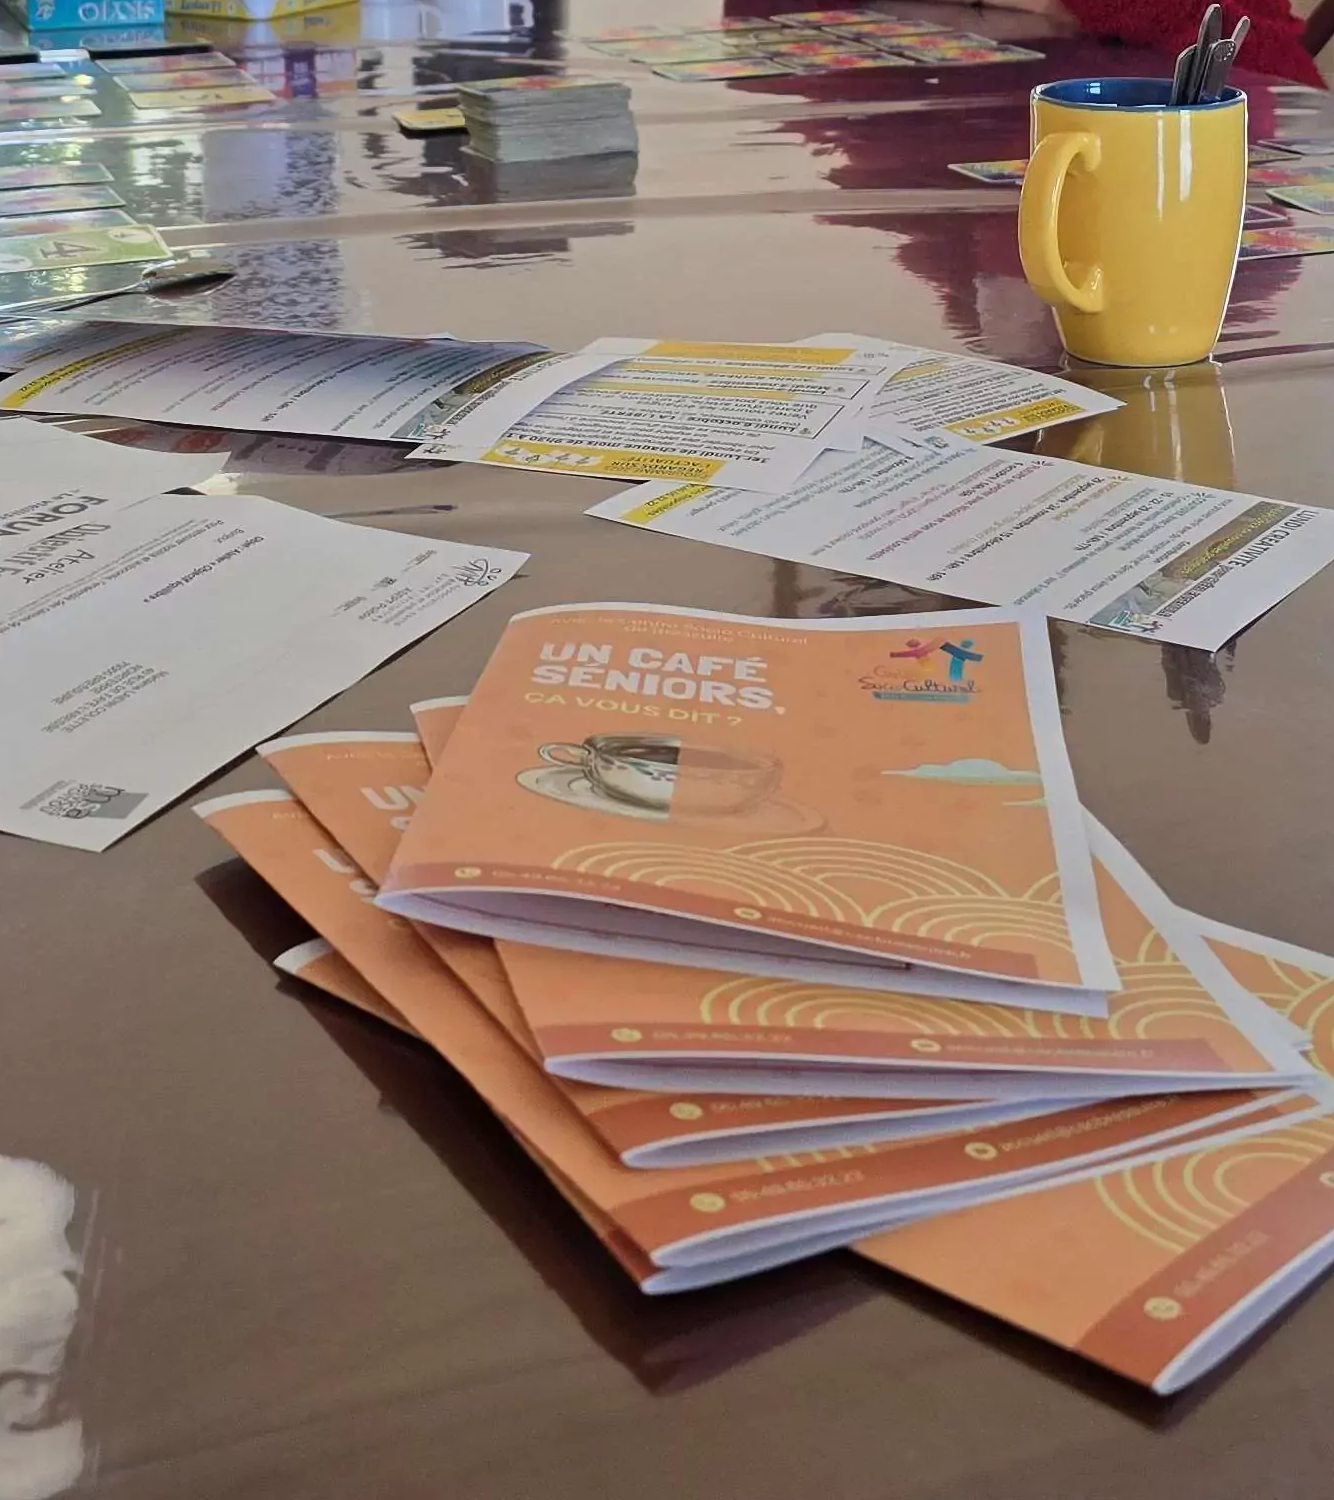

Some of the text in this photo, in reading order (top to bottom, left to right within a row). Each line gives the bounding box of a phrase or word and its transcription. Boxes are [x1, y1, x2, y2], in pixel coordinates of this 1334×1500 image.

[754, 422, 796, 434] Lundi
[565, 437, 584, 446] de
[586, 439, 623, 449] mois
[625, 441, 678, 455] chaque
[680, 448, 697, 457] de
[699, 450, 743, 462] Lundi
[1281, 509, 1319, 535] LUNDI
[1228, 528, 1288, 568] CREATIVITE
[22, 549, 96, 586] Atelier
[539, 641, 768, 684] UN CAFÉ
[531, 662, 786, 716] SÉNIORS,
[524, 691, 569, 706] ÇA
[574, 695, 661, 718] VOUS
[668, 707, 722, 726] DIT
[61, 786, 125, 820] msa
